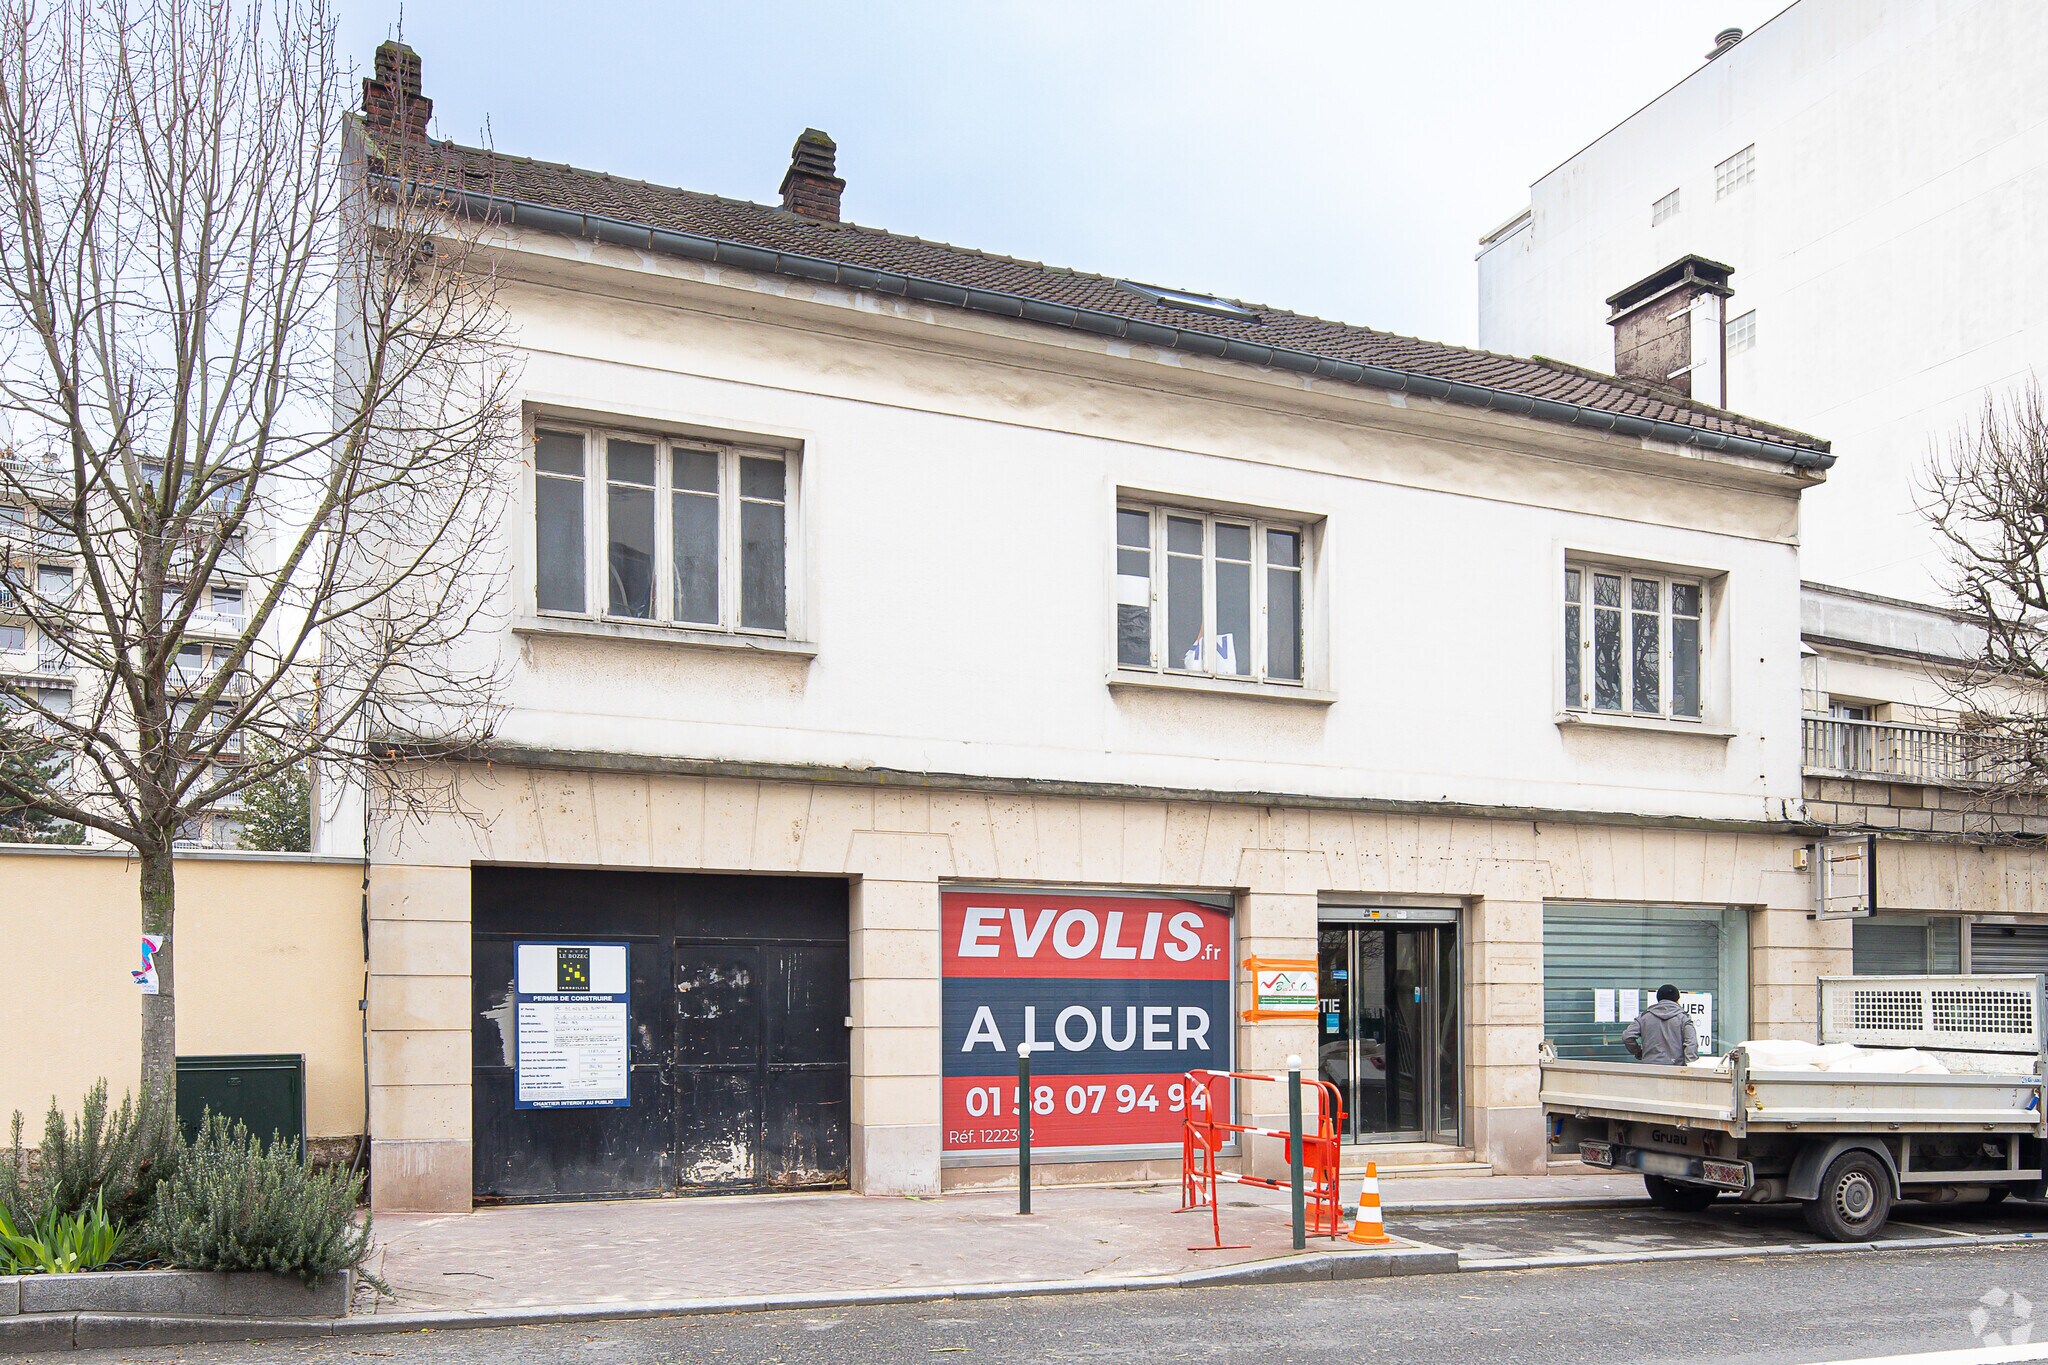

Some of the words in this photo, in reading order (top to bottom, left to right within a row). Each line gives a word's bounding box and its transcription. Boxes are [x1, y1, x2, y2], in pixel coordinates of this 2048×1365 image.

[1318, 999, 1340, 1013] TIE
[961, 1006, 1007, 1052] A
[1024, 1005, 1210, 1052] LOUER
[1700, 1035, 1711, 1047] 70
[965, 1086, 1001, 1117] 01
[1065, 1085, 1106, 1115] 07
[1116, 1084, 1159, 1113] 94
[949, 1130, 976, 1144] Réf.
[980, 1128, 1035, 1143] 122232
[1652, 1130, 1687, 1146] Gruau
